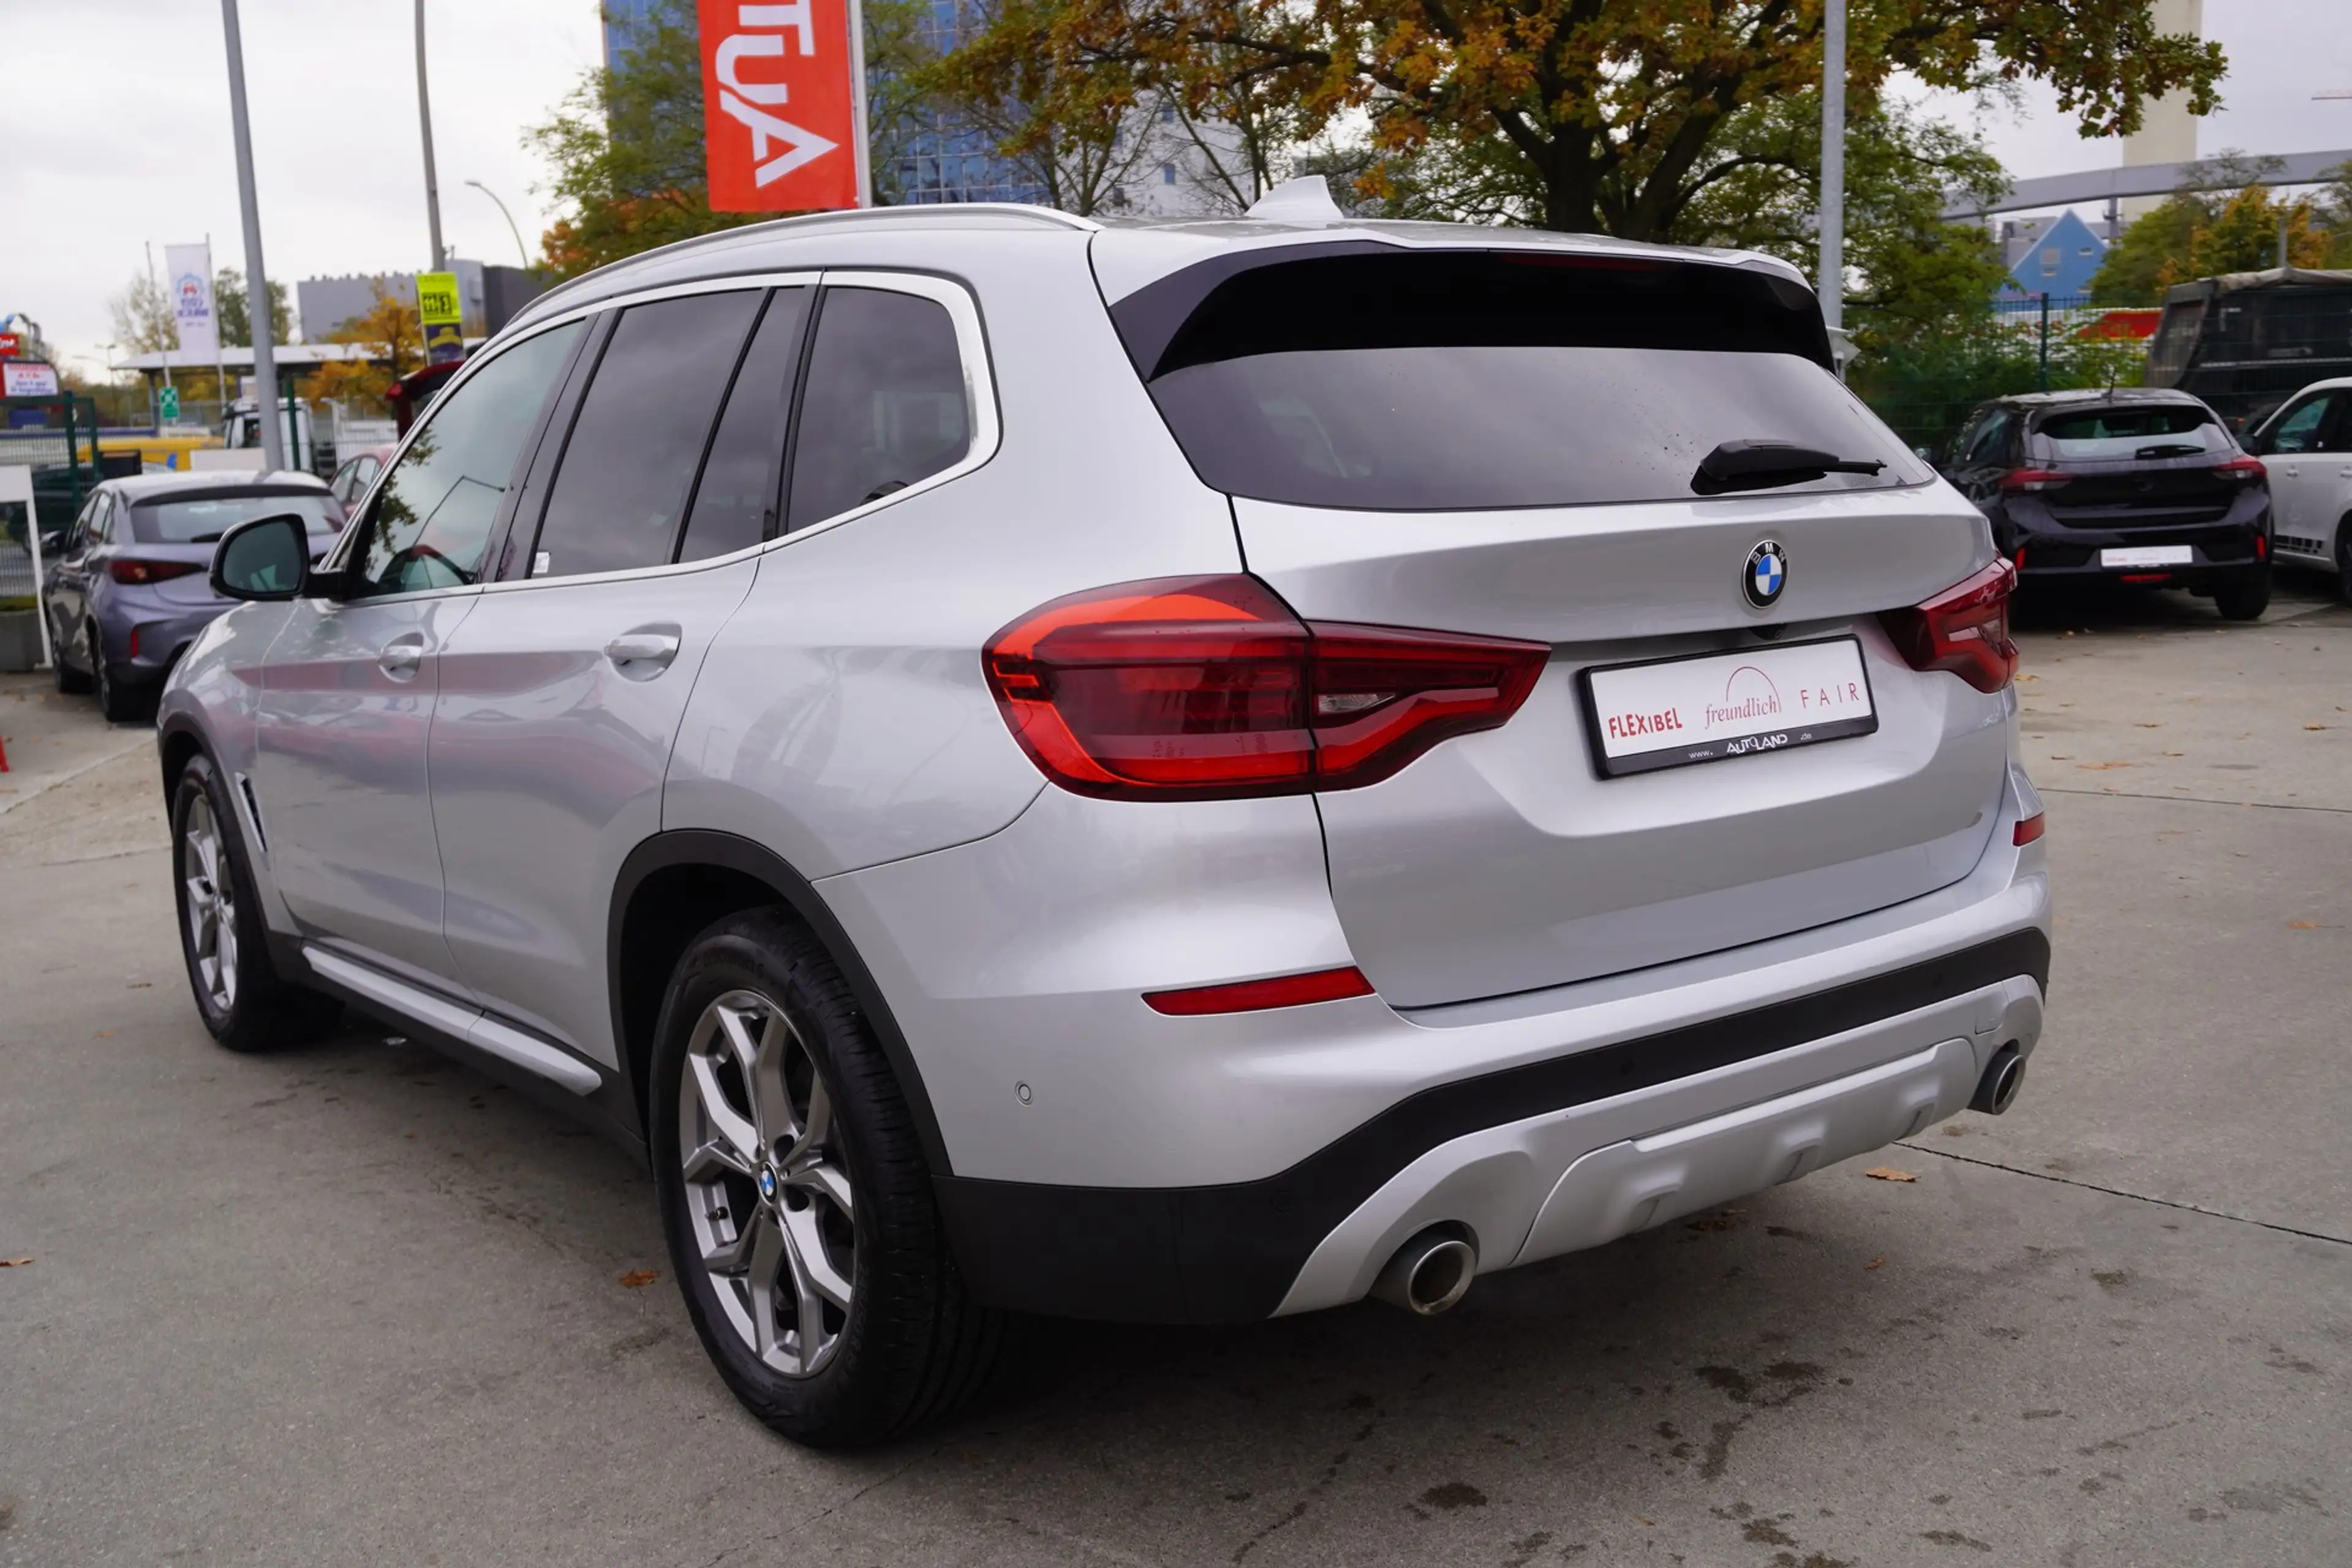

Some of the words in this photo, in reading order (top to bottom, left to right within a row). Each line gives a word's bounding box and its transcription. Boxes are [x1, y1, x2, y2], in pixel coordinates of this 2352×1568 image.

[1750, 542, 1787, 565] BMW
[1608, 707, 1683, 739] FLEXIBEL
[1705, 695, 1777, 729] freundlich
[1726, 733, 1789, 755] AUTOLAND
